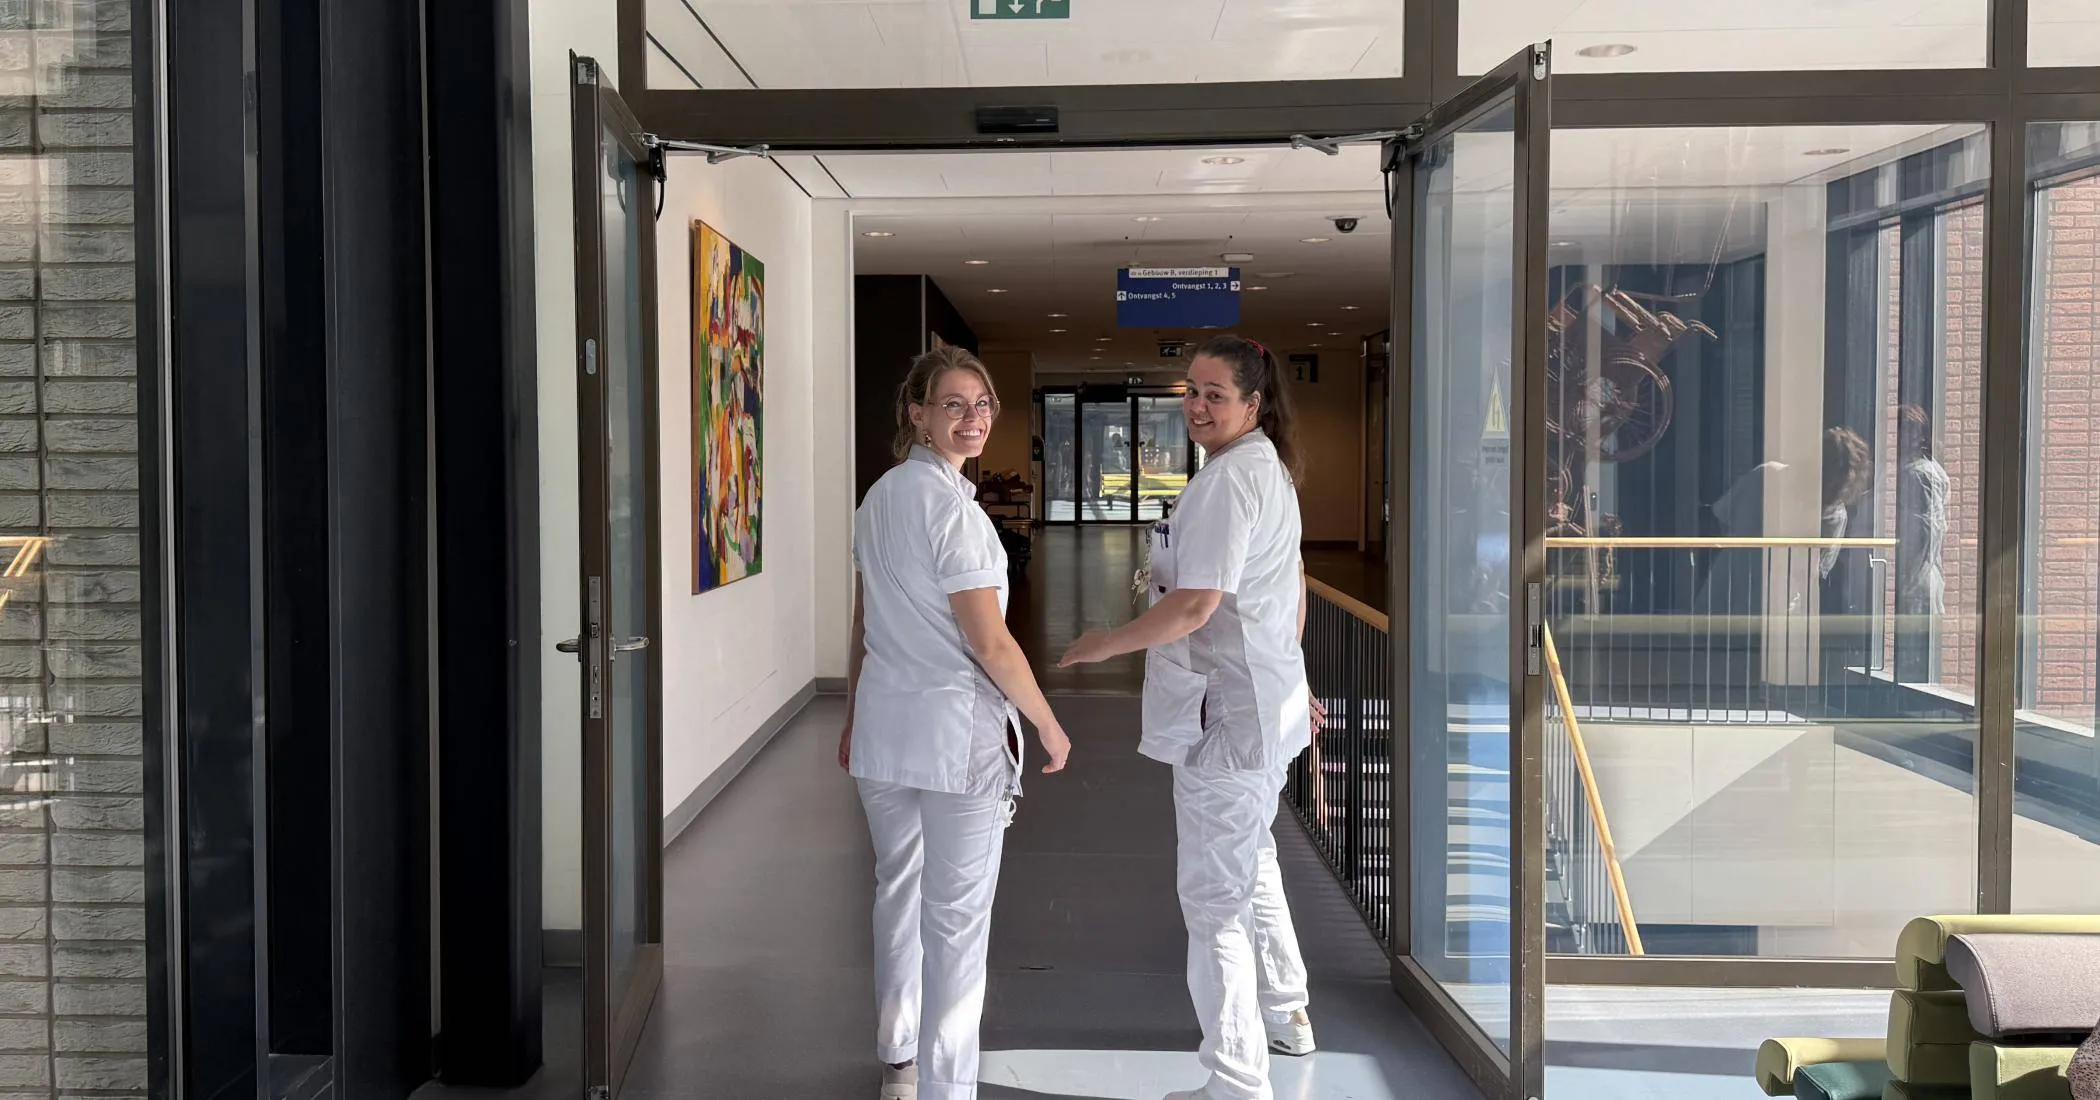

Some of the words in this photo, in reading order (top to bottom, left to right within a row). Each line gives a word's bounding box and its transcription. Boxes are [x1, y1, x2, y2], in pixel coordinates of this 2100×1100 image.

[1178, 269, 1213, 277] verdieping
[1172, 282, 1206, 290] Ontvangst
[1214, 282, 1222, 290] 2,
[1222, 282, 1227, 290] 3
[1128, 292, 1162, 300] Ontvangst
[1171, 292, 1176, 300] 5
